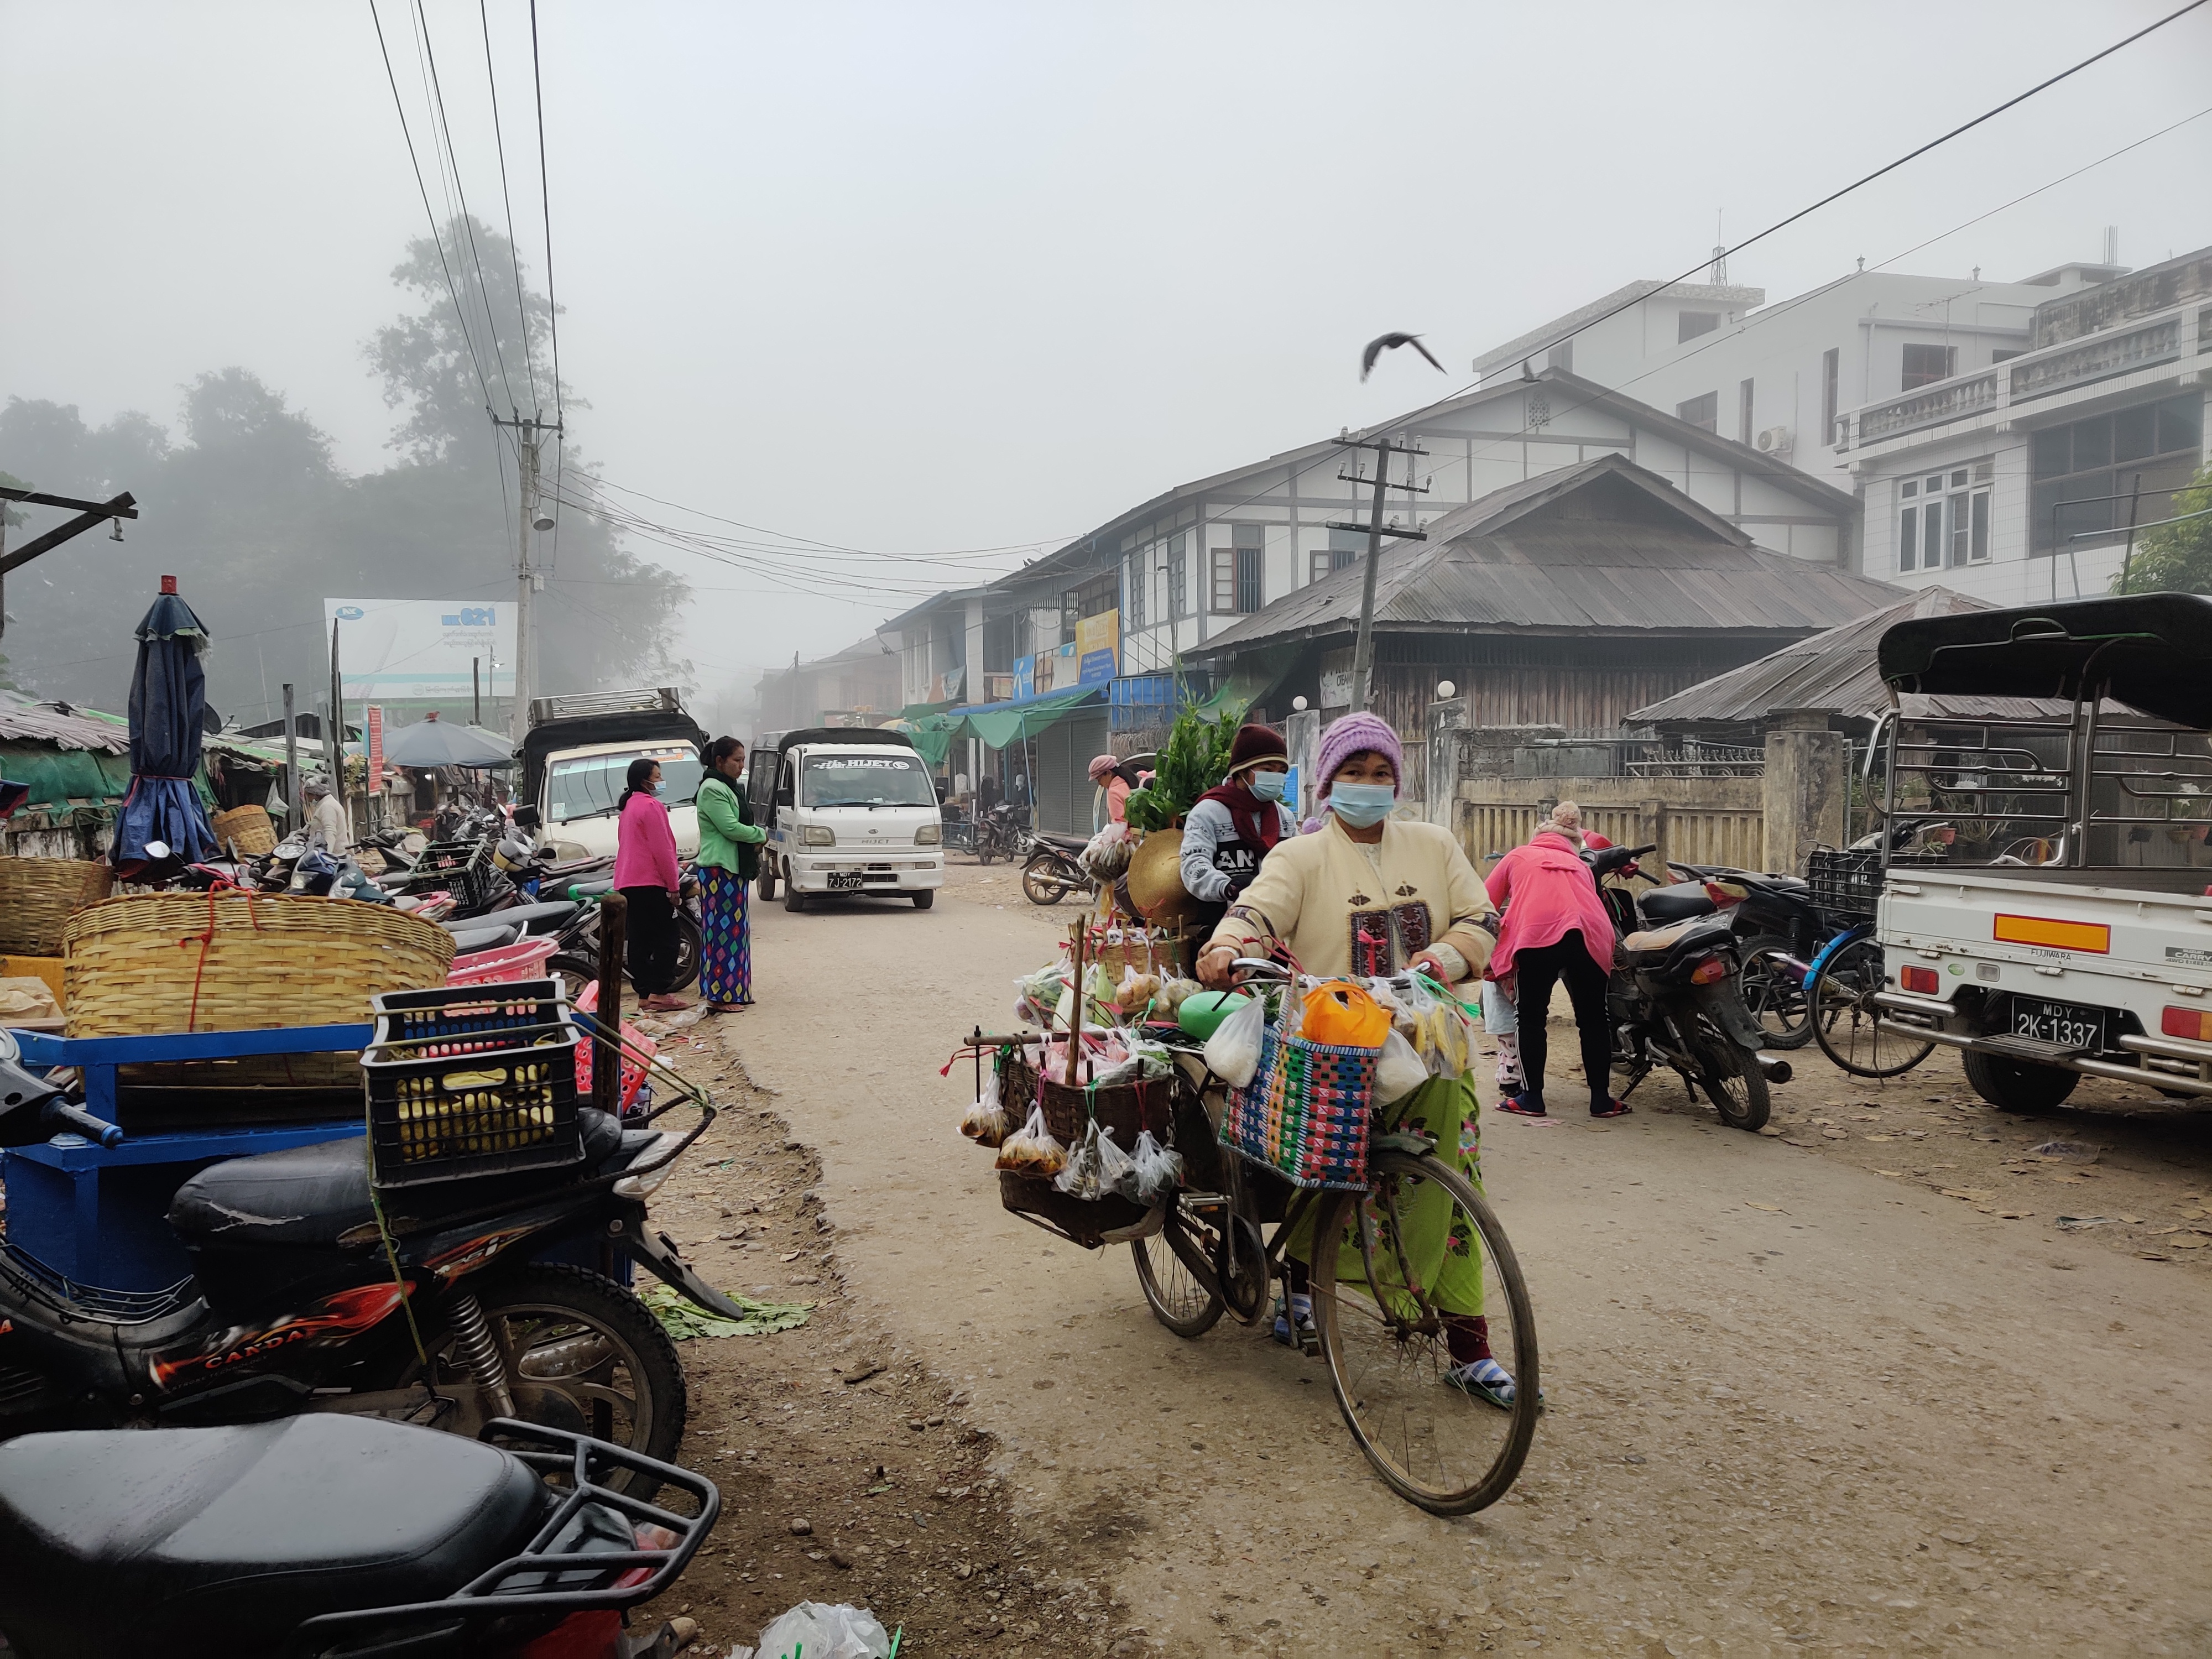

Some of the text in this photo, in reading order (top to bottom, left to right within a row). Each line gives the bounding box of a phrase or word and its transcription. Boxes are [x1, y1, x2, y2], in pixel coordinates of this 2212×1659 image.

[829, 877, 862, 888] 7J-2172
[2031, 949, 2071, 961] FUJIWARA
[2175, 952, 2212, 962] CARRY
[2043, 1003, 2073, 1019] MDY
[2018, 1013, 2098, 1047] 2K-1337
[205, 1331, 304, 1369] CANDA
